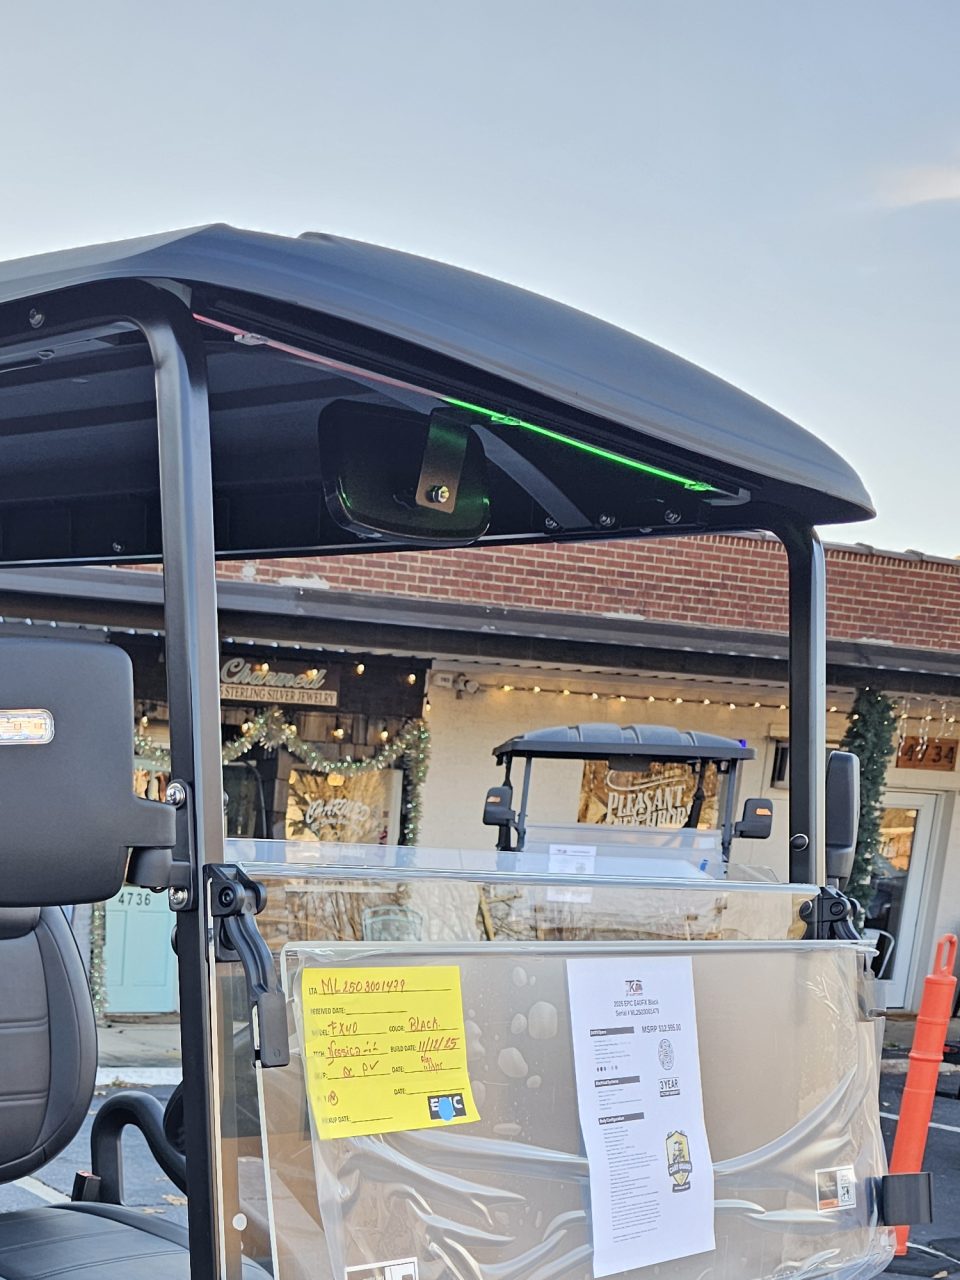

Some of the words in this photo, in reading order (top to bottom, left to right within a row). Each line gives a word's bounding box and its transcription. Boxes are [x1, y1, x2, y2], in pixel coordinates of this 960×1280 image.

[220, 658, 327, 689] Charmed
[225, 686, 266, 700] STERLING
[267, 688, 297, 702] SILVER
[298, 691, 335, 705] JEWELRY
[904, 743, 954, 764] 4734
[606, 785, 686, 821] PLEASANT
[118, 892, 152, 906] 4736
[312, 1028, 330, 1036] MDEL:
[641, 1025, 658, 1034] MSRP
[664, 1078, 679, 1089] YEAR
